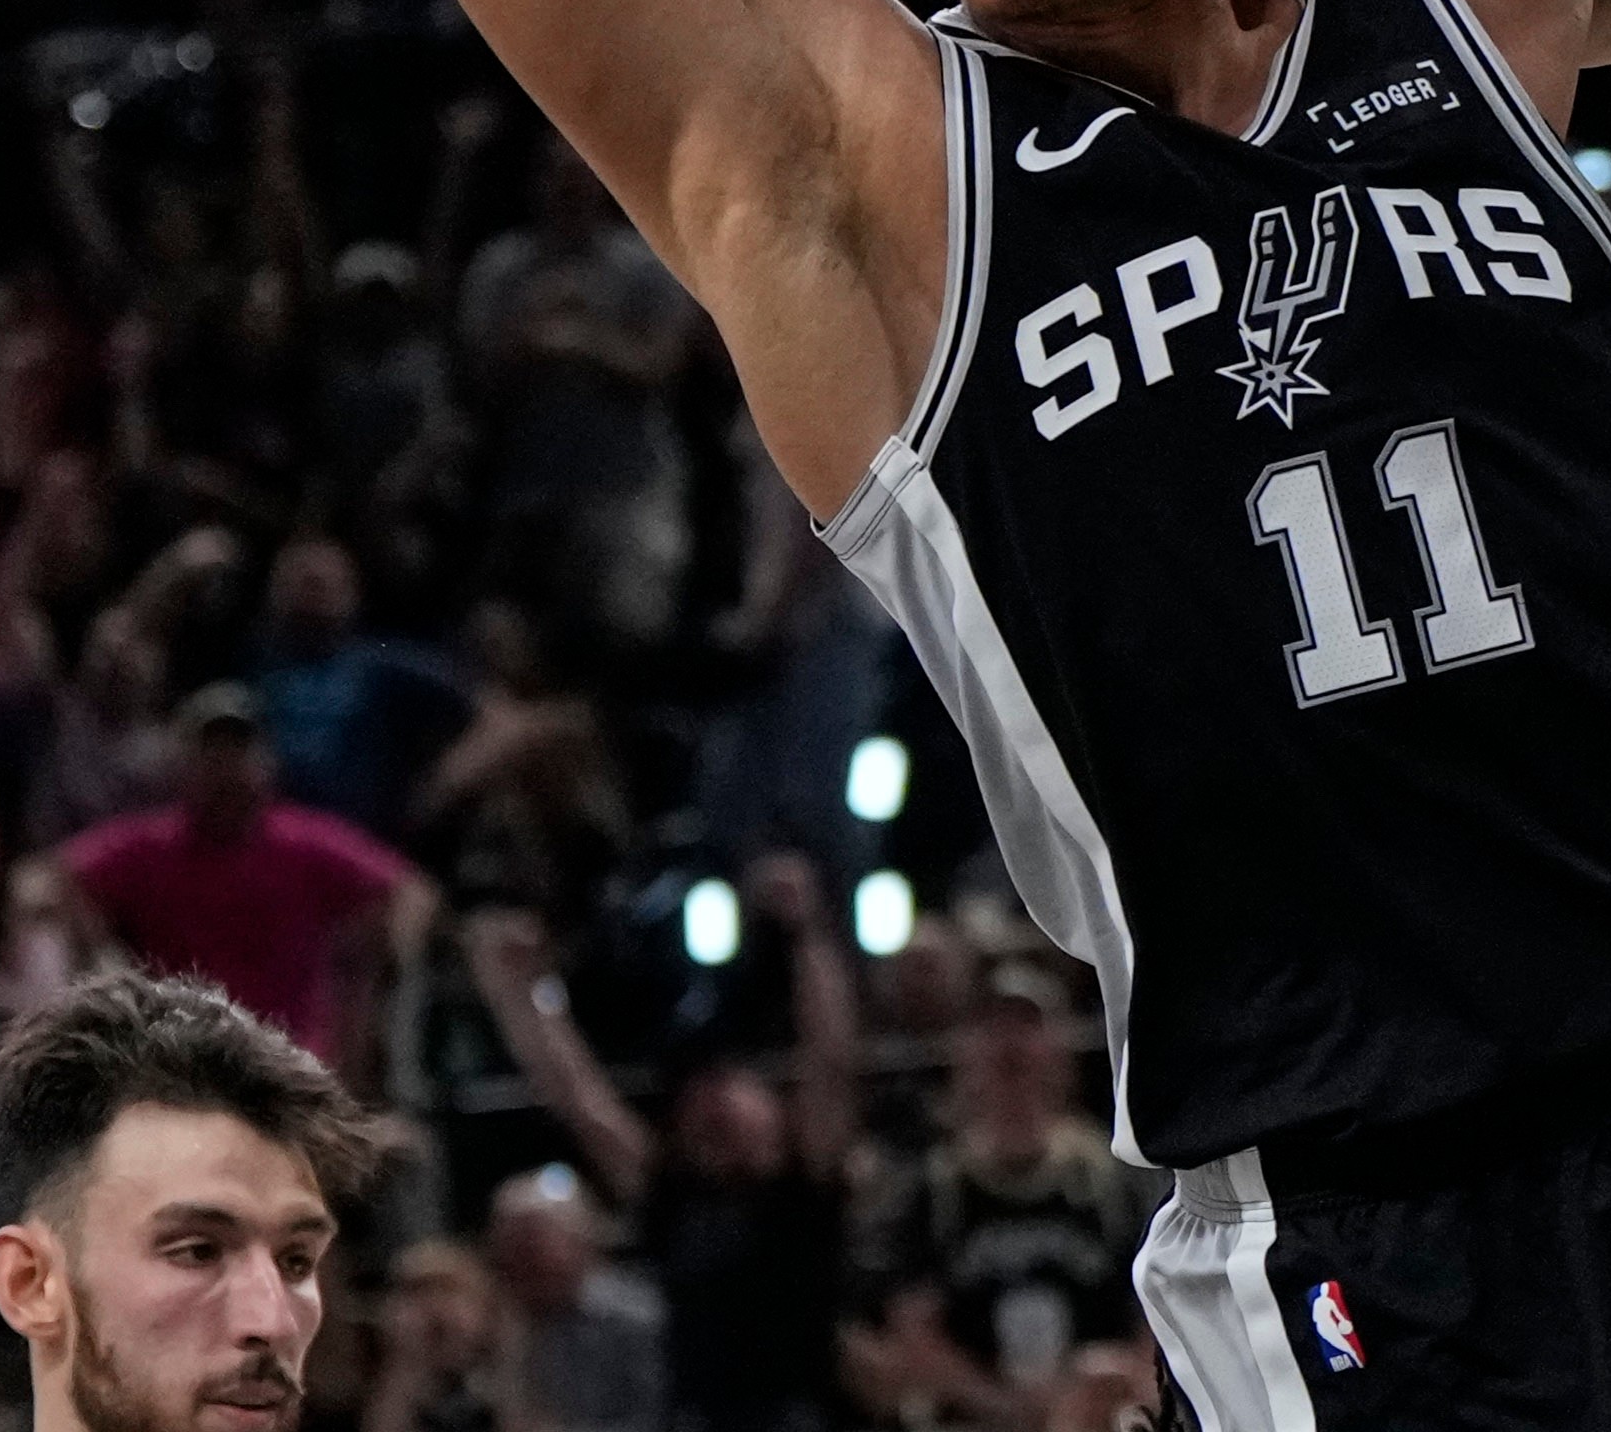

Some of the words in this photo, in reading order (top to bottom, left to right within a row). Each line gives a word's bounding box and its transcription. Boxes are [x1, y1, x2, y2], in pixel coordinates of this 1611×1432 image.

[1333, 77, 1437, 131] LEDGER
[1014, 184, 1572, 441] SPURS
[1244, 418, 1535, 709] 11
